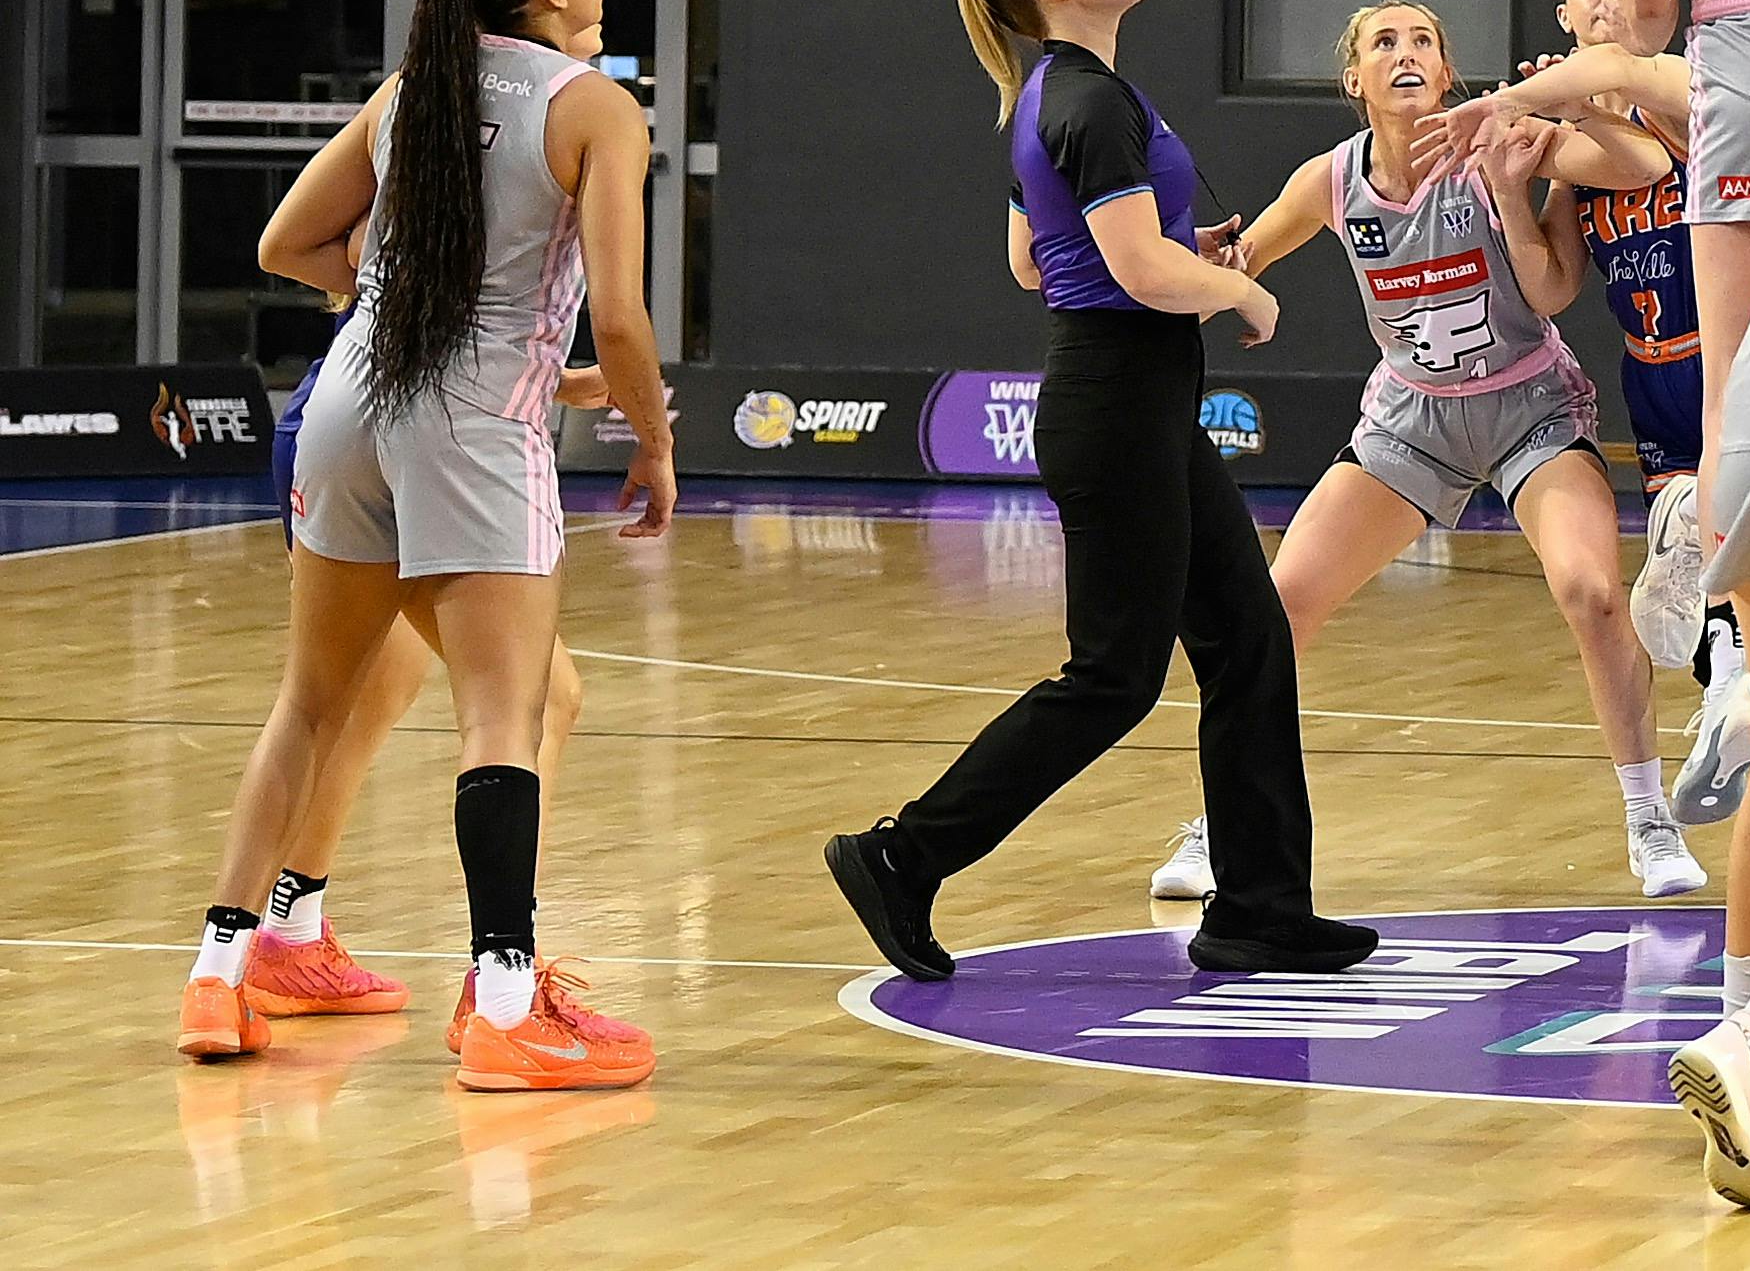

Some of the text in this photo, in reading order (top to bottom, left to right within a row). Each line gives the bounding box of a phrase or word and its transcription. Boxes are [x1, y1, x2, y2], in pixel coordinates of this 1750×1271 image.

[1373, 274, 1421, 291] Harvey
[1631, 290, 1662, 336] 7
[795, 400, 888, 432] SPIRIT
